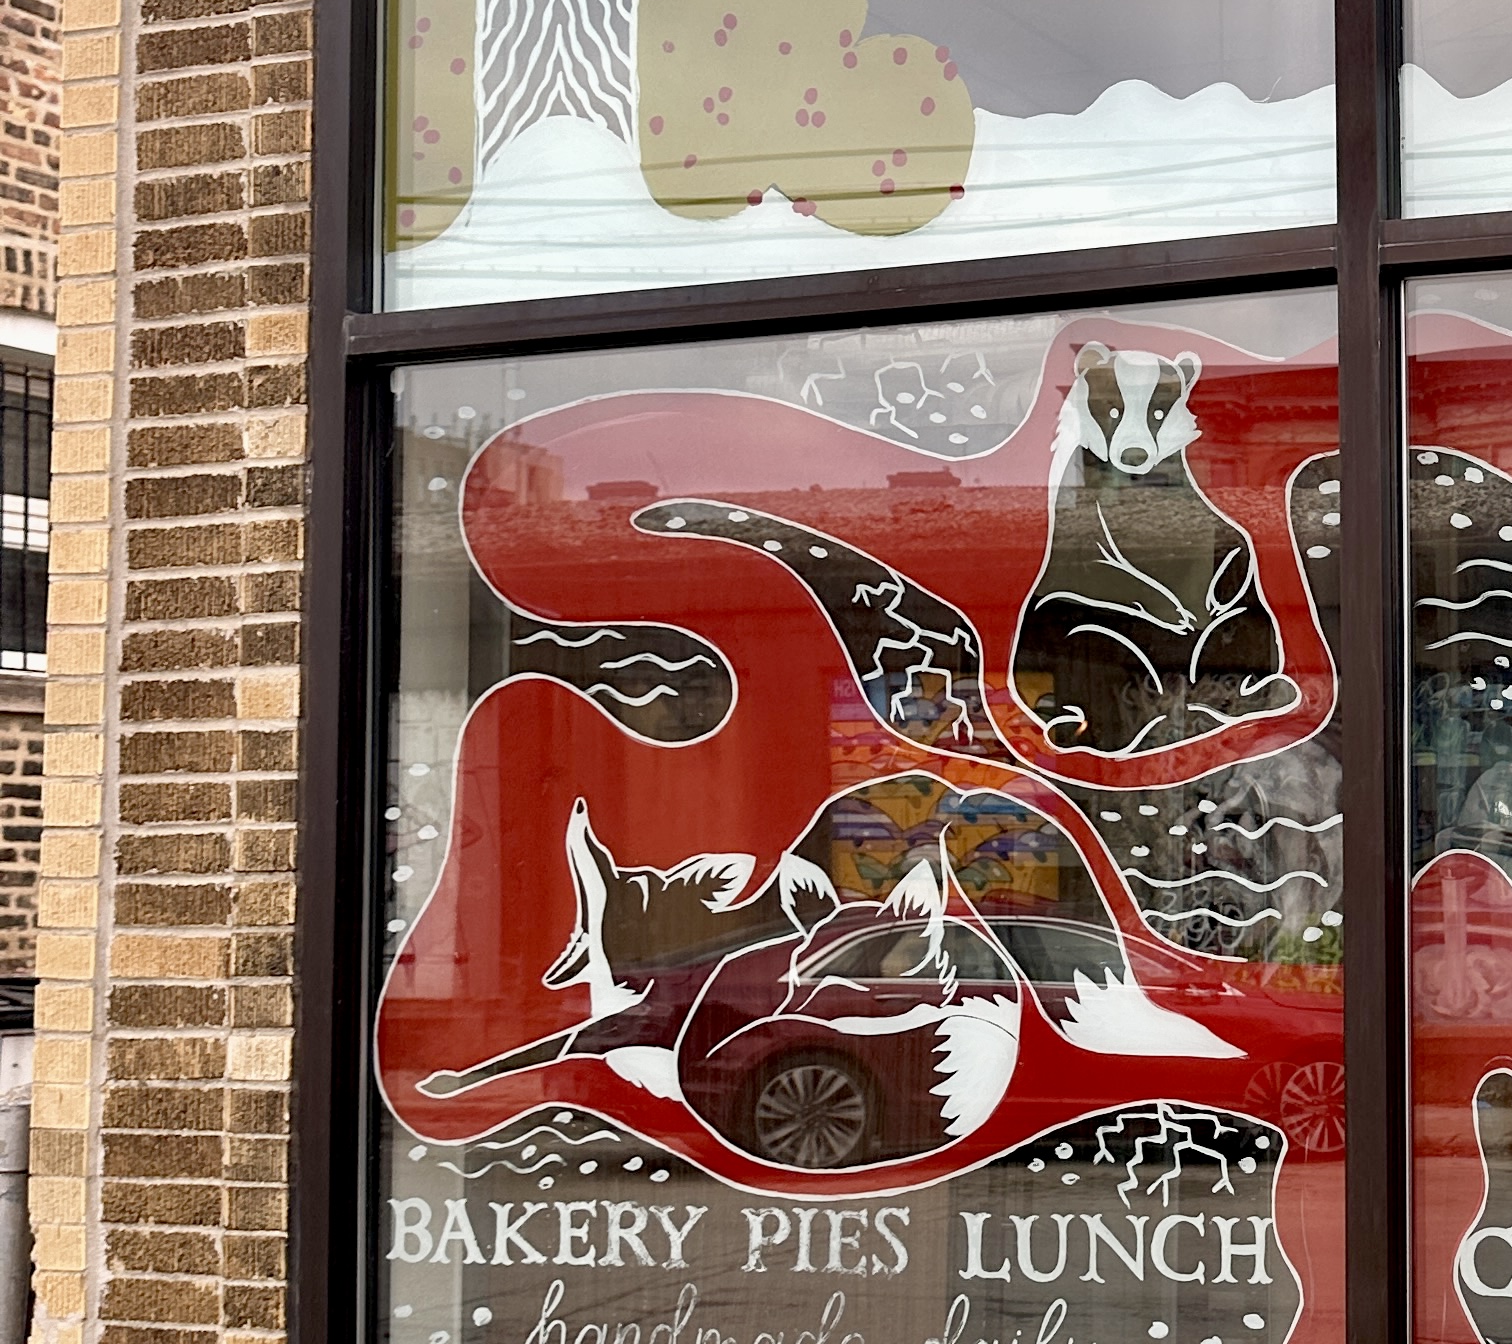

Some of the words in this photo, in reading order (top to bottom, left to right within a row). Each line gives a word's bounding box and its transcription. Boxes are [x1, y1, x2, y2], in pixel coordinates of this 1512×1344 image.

[385, 1197, 709, 1270] BAKERY
[740, 1206, 911, 1279] PIES
[959, 1211, 1274, 1285] LUNCH
